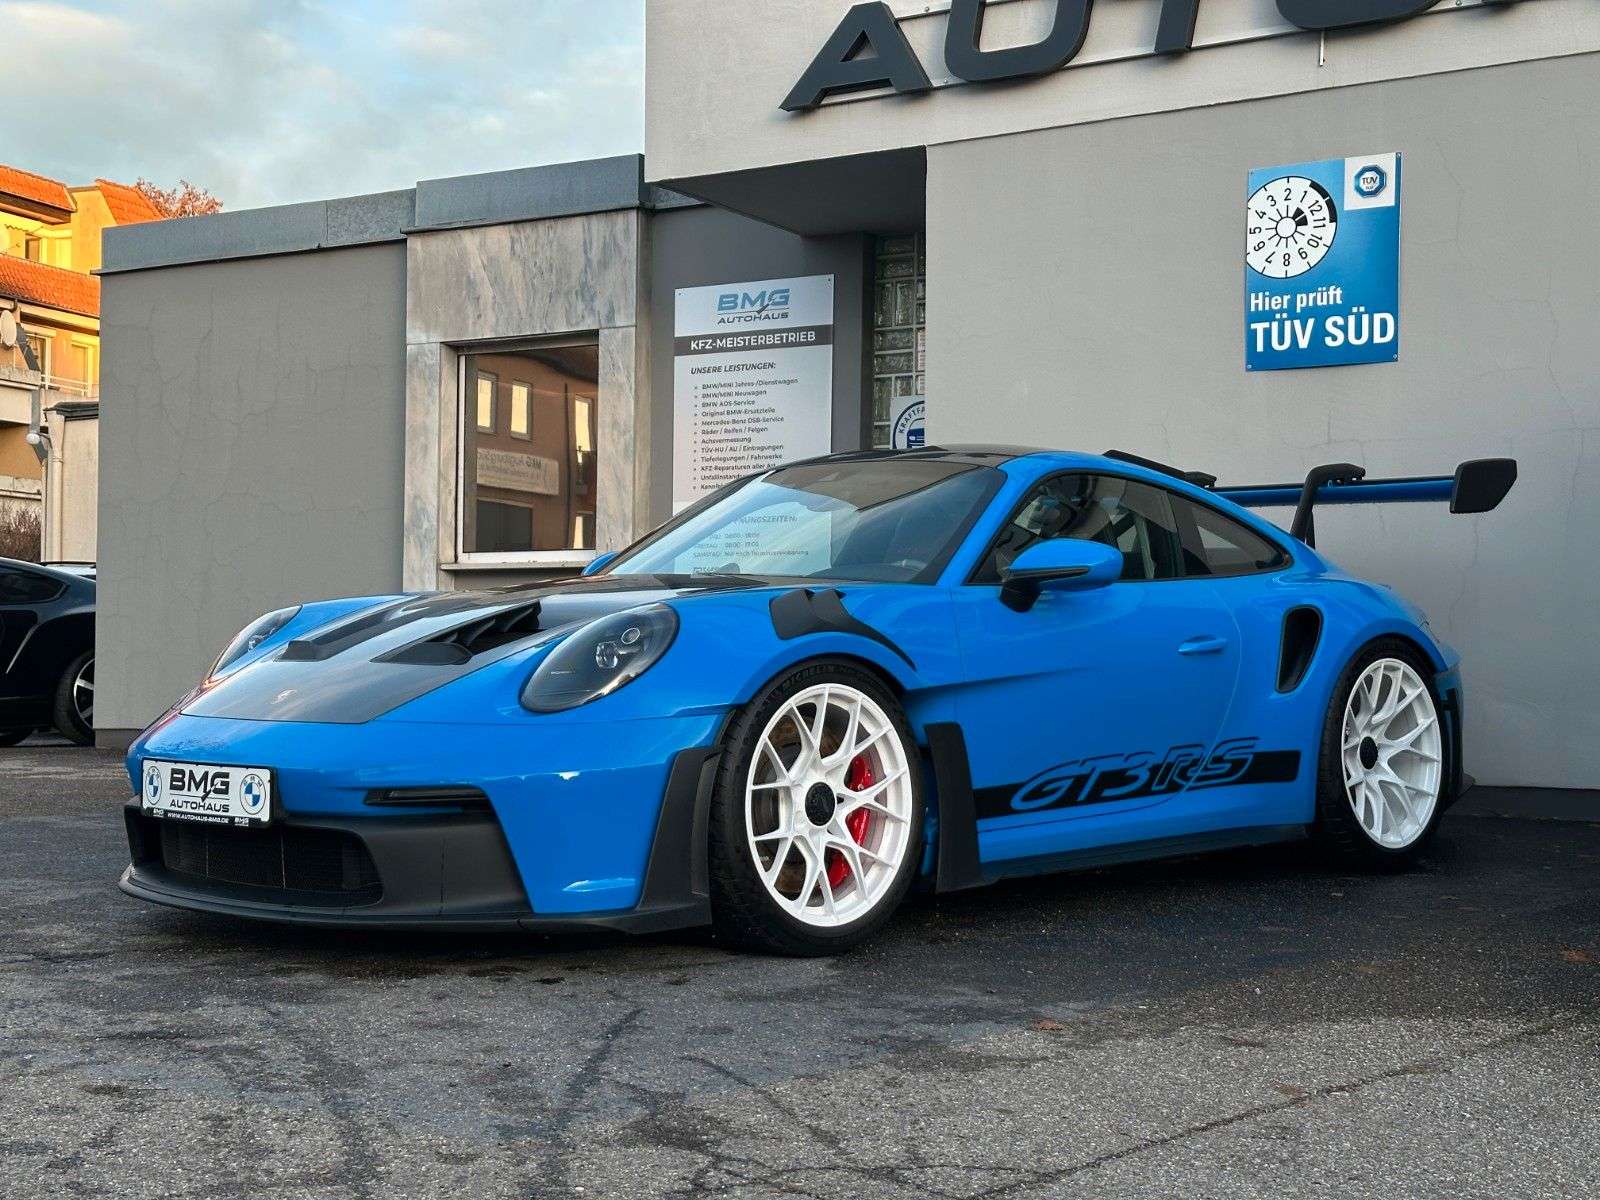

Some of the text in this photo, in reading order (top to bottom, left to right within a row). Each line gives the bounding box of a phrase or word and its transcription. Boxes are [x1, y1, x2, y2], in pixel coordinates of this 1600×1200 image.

[1362, 176, 1378, 185] TÜV
[1266, 195, 1277, 207] 3
[1284, 188, 1292, 201] 2
[1300, 190, 1308, 203] 1
[1255, 209, 1267, 219] 4
[1308, 200, 1323, 216] 12
[1313, 217, 1326, 228] 11
[1249, 226, 1262, 234] 5
[1253, 241, 1266, 252] 6
[1307, 234, 1323, 249] 10
[1265, 251, 1276, 264] 7
[1283, 253, 1291, 267] 8
[1297, 247, 1308, 260] 9
[717, 288, 790, 312] BMG
[1250, 285, 1343, 313] Hier prüft
[717, 312, 790, 325] AUTOHAUS
[1250, 306, 1395, 353] TÜV SÜD
[691, 331, 816, 350] KFZ-MEISTERBETRIEB
[691, 362, 777, 374] UNSERE LEISTUNGEN:
[701, 410, 725, 418] Original
[701, 418, 746, 426] Mercedes-Benz
[748, 426, 769, 434] Felgen
[743, 443, 784, 452] Eintragungen
[701, 455, 745, 463] Tieferlegungen
[170, 768, 230, 795] BMG
[170, 799, 230, 813] AUTOHAUS
